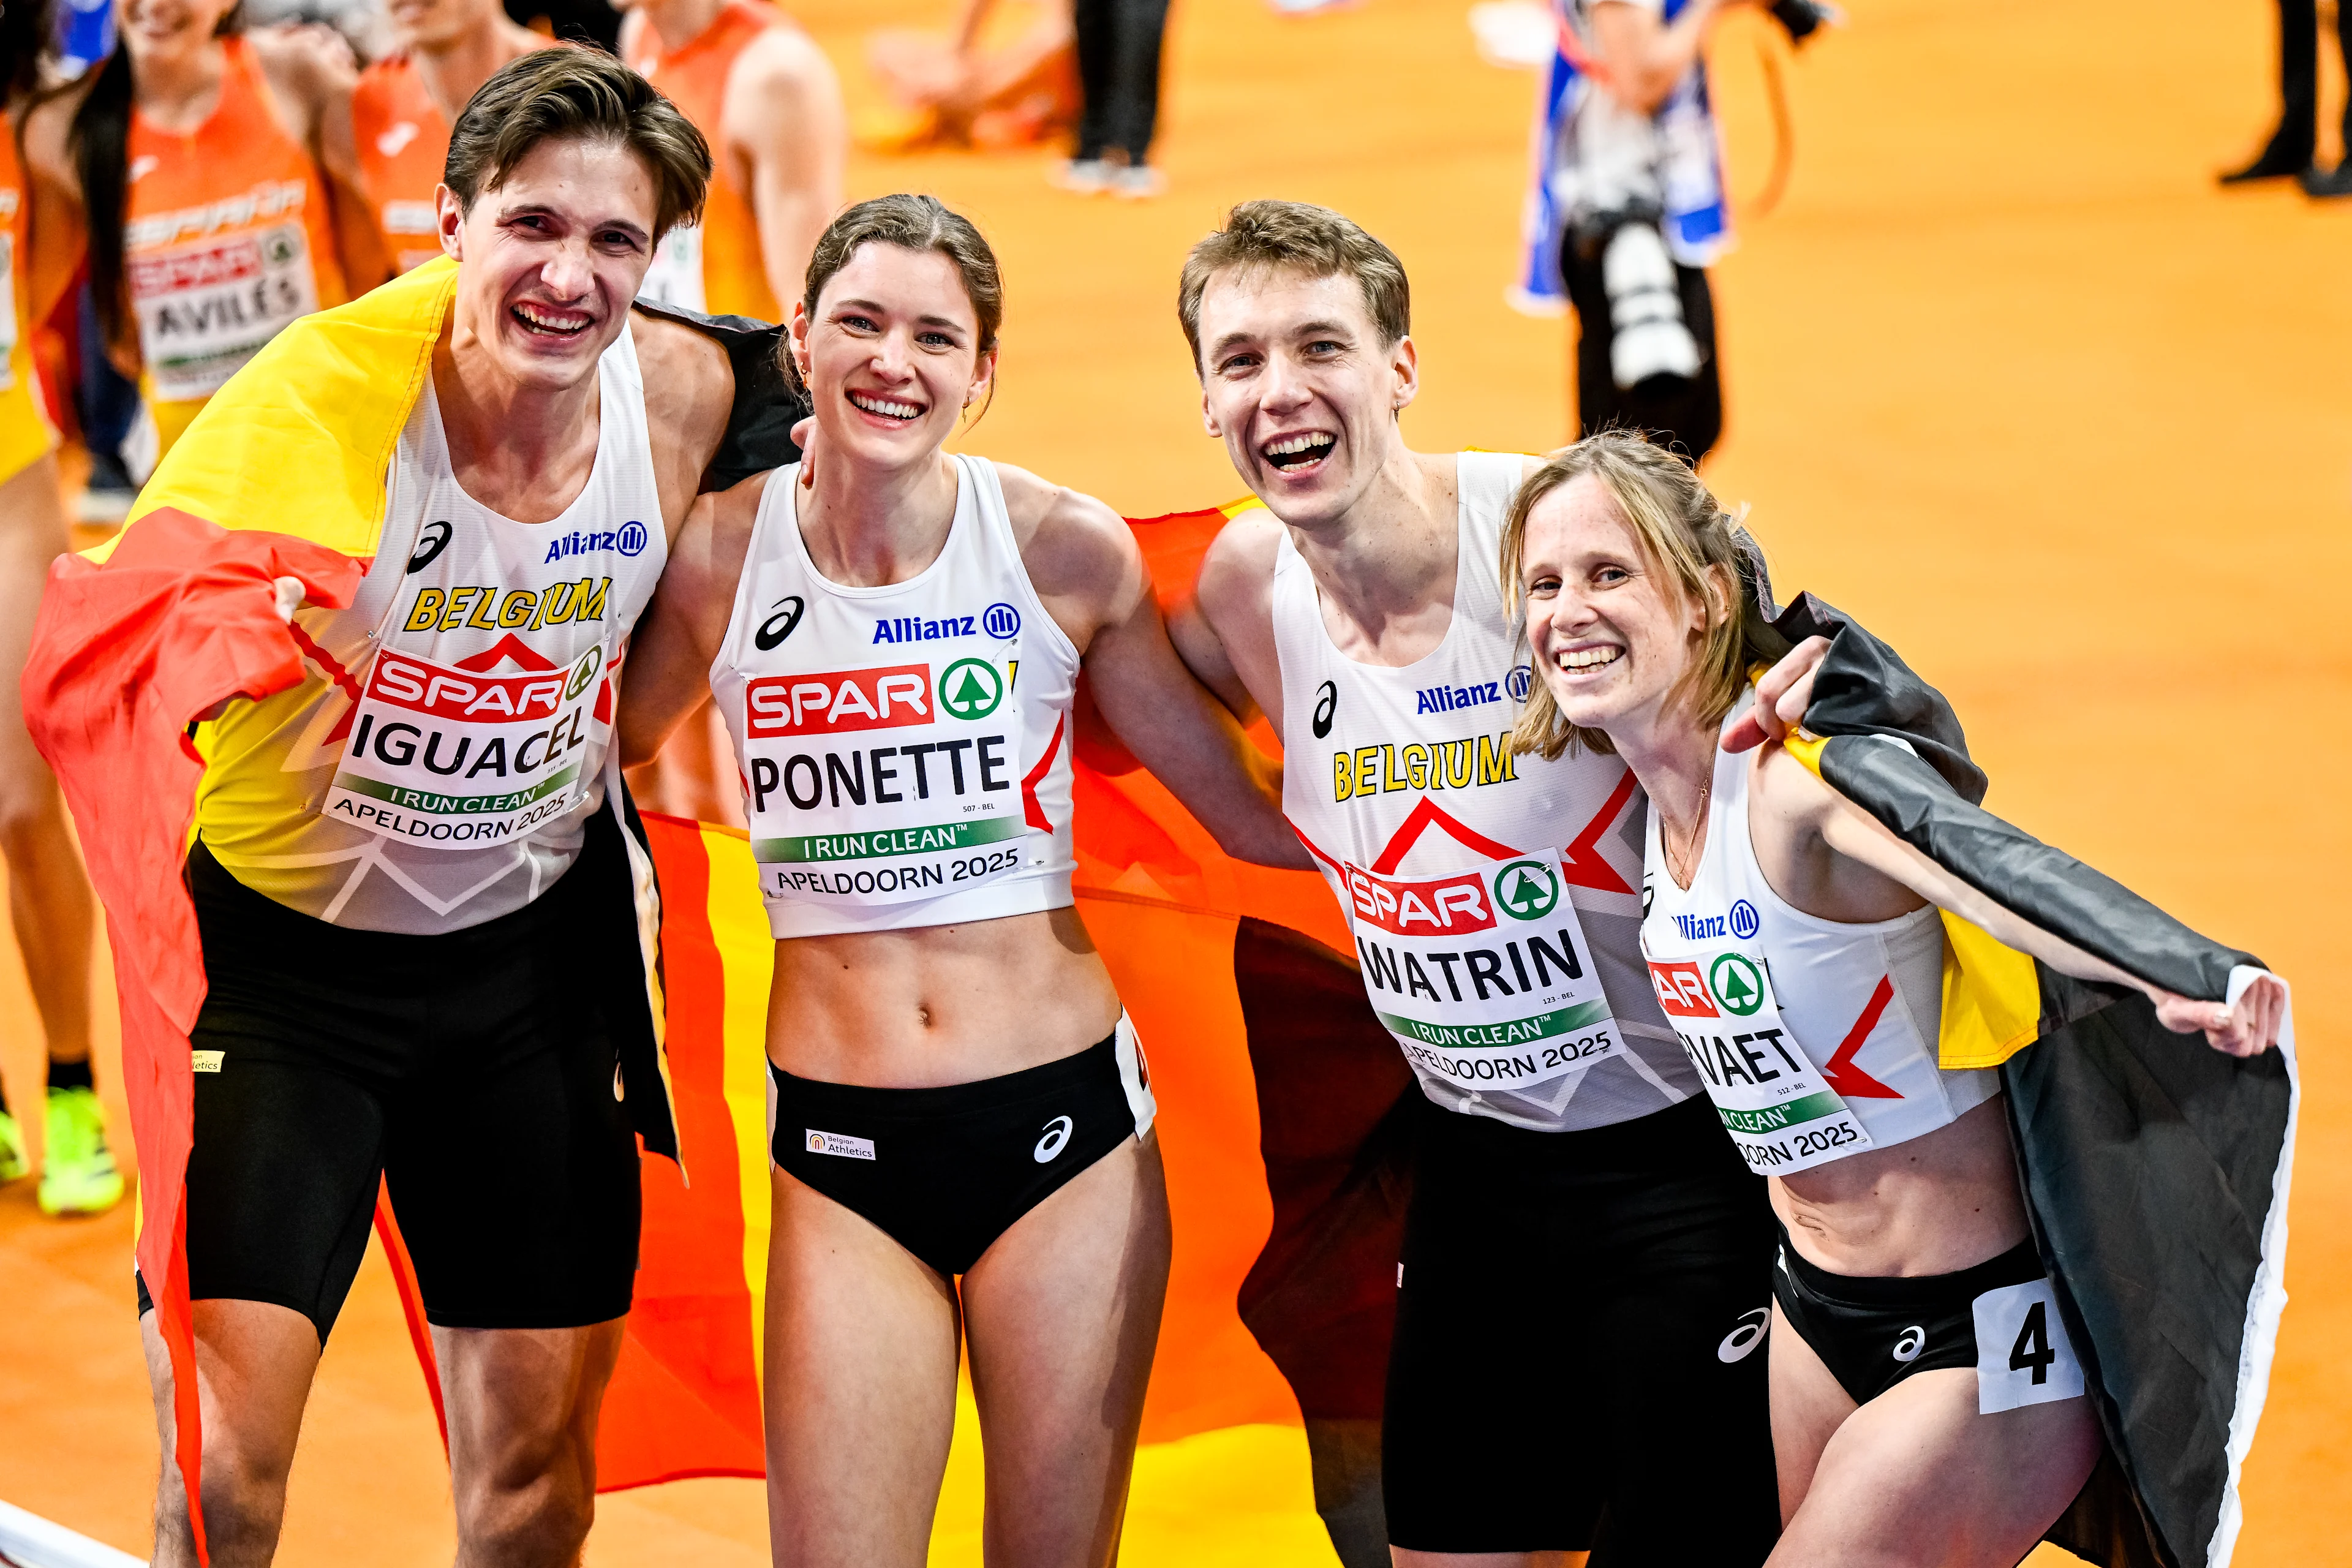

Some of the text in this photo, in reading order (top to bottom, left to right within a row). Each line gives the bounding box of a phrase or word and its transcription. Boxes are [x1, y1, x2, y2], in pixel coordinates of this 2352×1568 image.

[544, 532, 616, 564] Allianz
[402, 577, 612, 633] BELGIUM
[872, 615, 976, 644] Allianz
[377, 660, 564, 715] SPAR
[751, 673, 928, 729] SPAR
[1416, 682, 1502, 715] Allianz
[352, 706, 584, 778] IGUACEL
[751, 735, 1010, 813] PONETTE
[1334, 730, 1520, 803] BELGIUM
[333, 792, 568, 840] APELDOORN 2025
[390, 788, 399, 802] I
[402, 794, 458, 812] RUN
[804, 840, 810, 859] I
[816, 837, 867, 858] RUN
[778, 848, 1019, 895] APELDOORN 2025
[1351, 873, 1488, 927] SPAR
[1672, 914, 1726, 940] llianz
[1357, 929, 1583, 1003] WATRIN
[1650, 969, 1713, 1009] AR
[1411, 1022, 1420, 1038] I
[1419, 1023, 1462, 1045] RUN
[1541, 1031, 1611, 1069] 2025
[828, 1136, 854, 1145] Belgian
[828, 1144, 872, 1157] Athletics
[1794, 1121, 1858, 1157] 2025
[2009, 1301, 2055, 1385] 4
